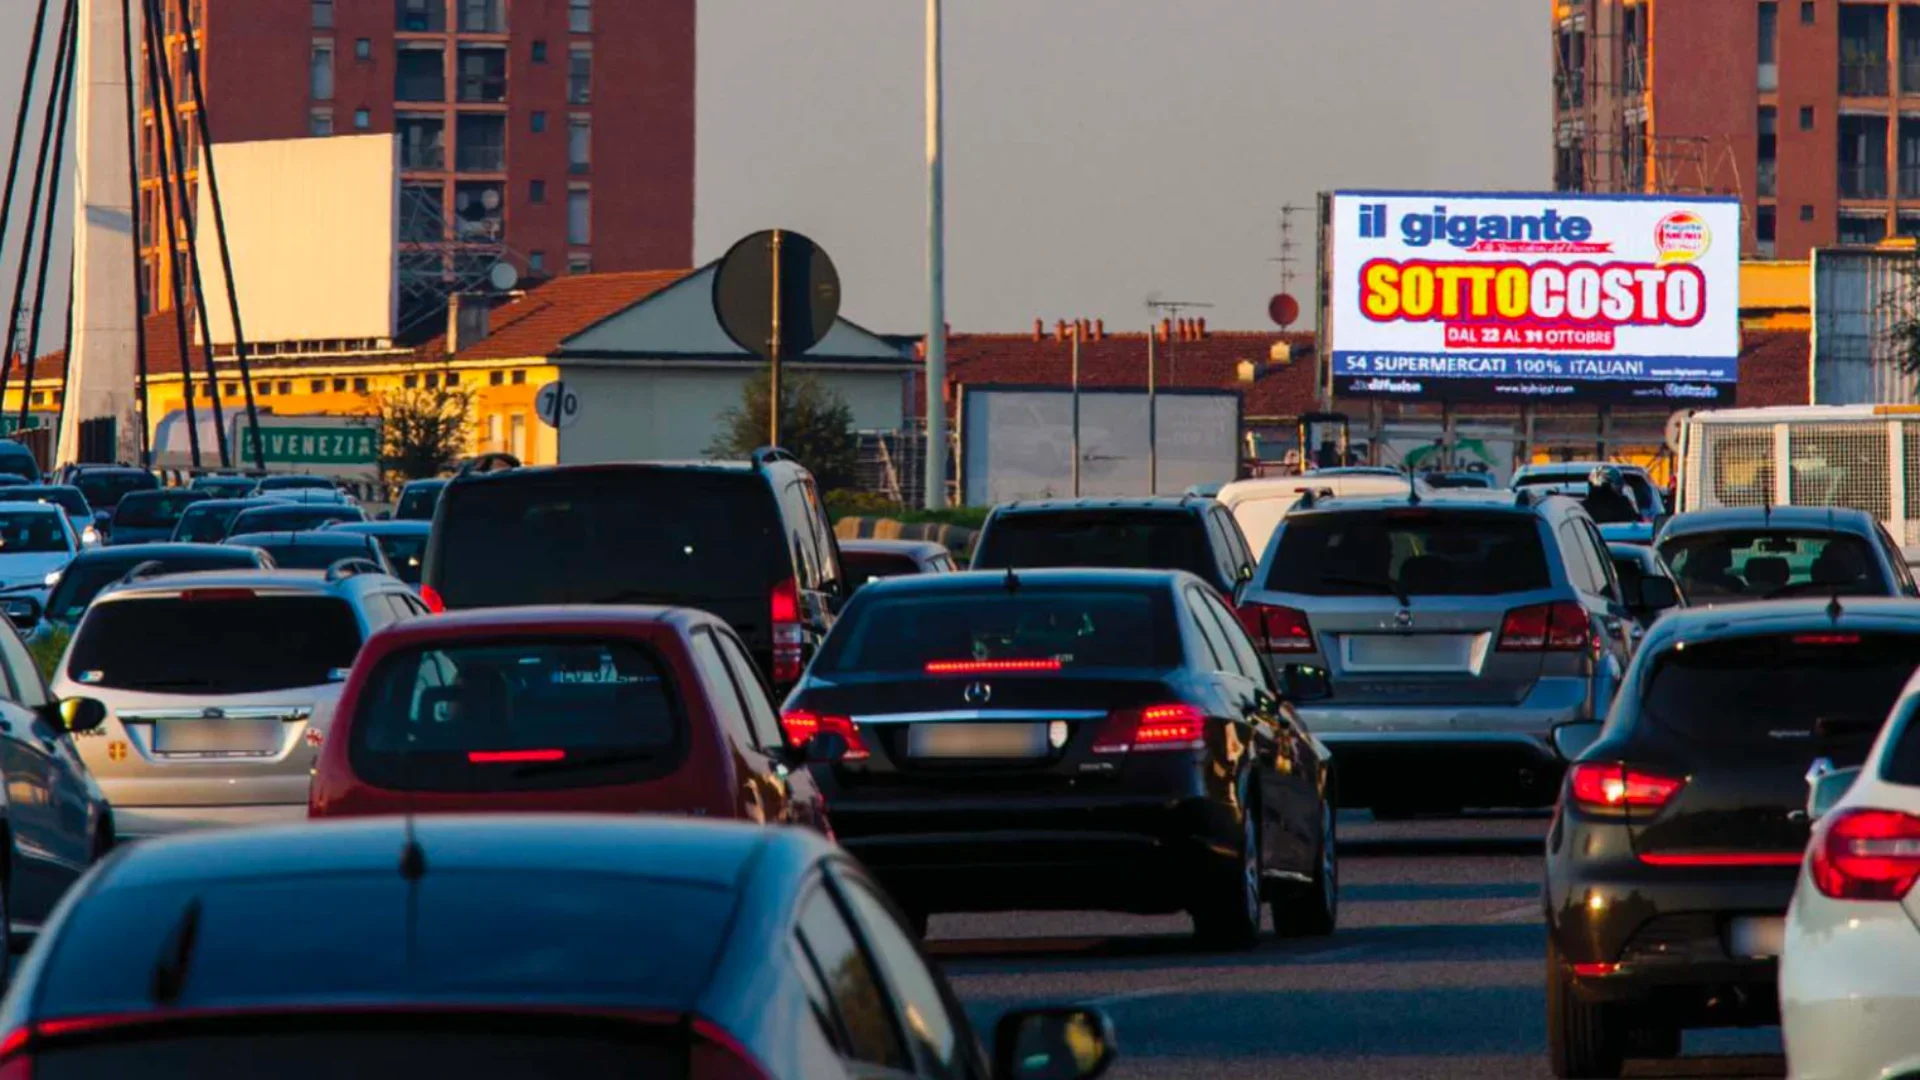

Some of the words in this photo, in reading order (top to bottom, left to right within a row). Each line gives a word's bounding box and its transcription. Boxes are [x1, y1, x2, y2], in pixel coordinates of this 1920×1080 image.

[1359, 204, 1386, 238] il
[1401, 206, 1592, 247] gigante
[1365, 265, 1701, 321] SOTTOCOSTO
[1448, 328, 1477, 343] DAL
[1503, 330, 1522, 343] AL
[1545, 331, 1611, 345] OTTOBRE
[1346, 355, 1367, 370] 54
[1374, 356, 1506, 373] SUPERMERCATI
[1515, 359, 1562, 374] 100%
[1570, 360, 1644, 375] ITALIANI
[544, 392, 578, 416] 70
